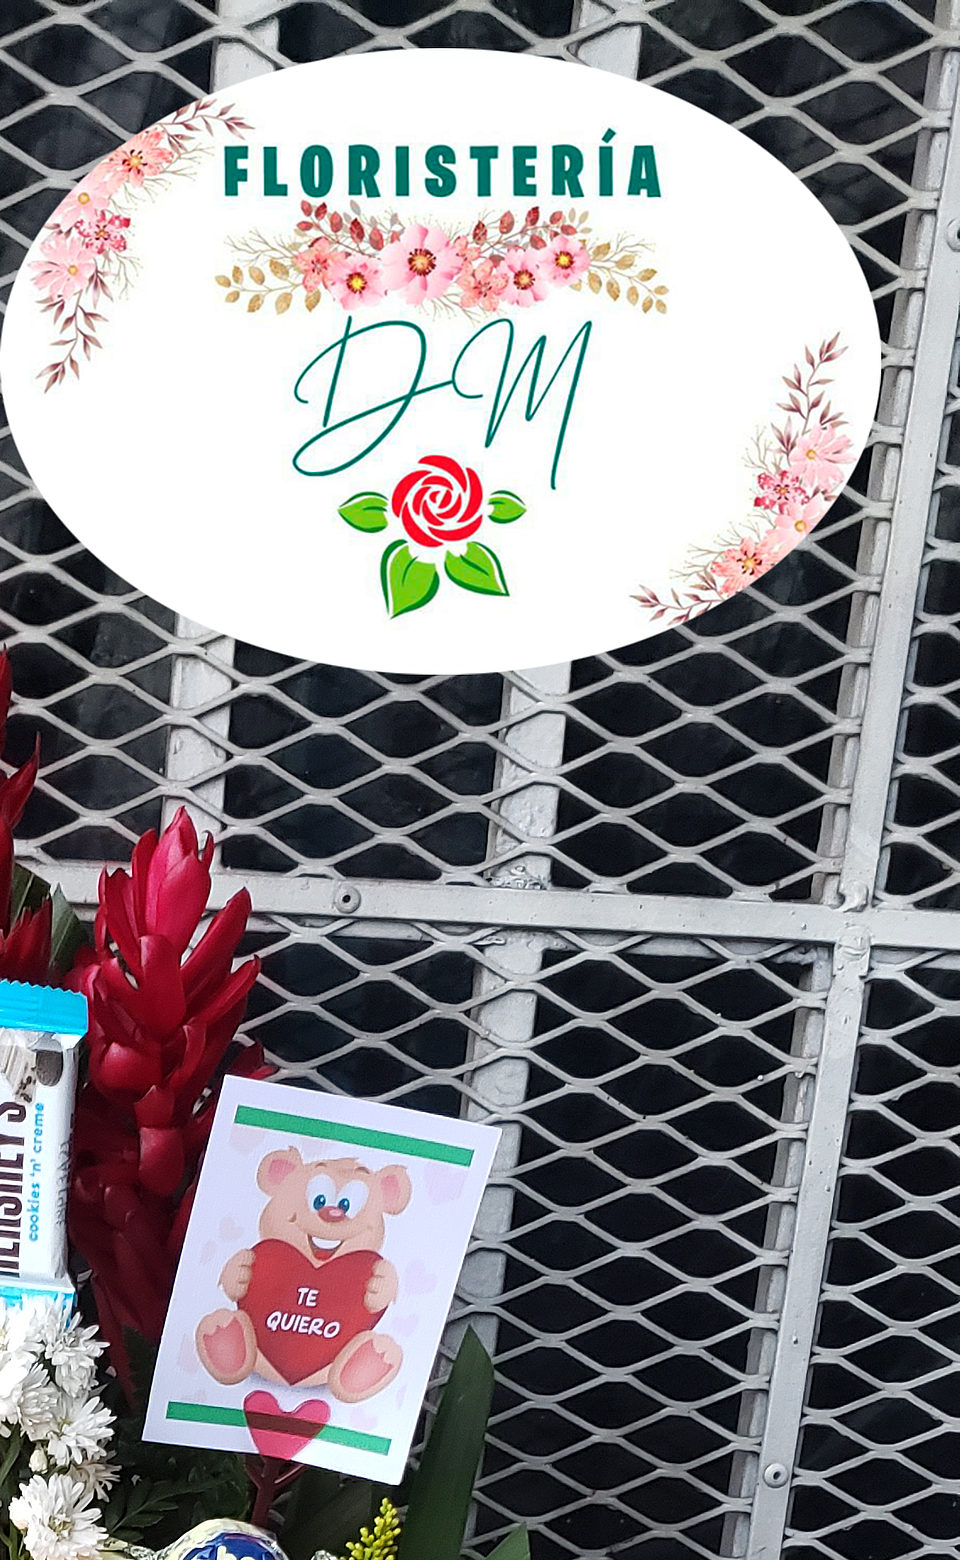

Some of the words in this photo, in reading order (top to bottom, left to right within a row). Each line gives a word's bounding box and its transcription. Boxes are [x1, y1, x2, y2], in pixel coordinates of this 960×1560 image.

[32, 1102, 45, 1154] creme
[26, 1178, 42, 1242] cookies
[296, 1287, 320, 1308] TE
[266, 1309, 341, 1339] QUIERO
